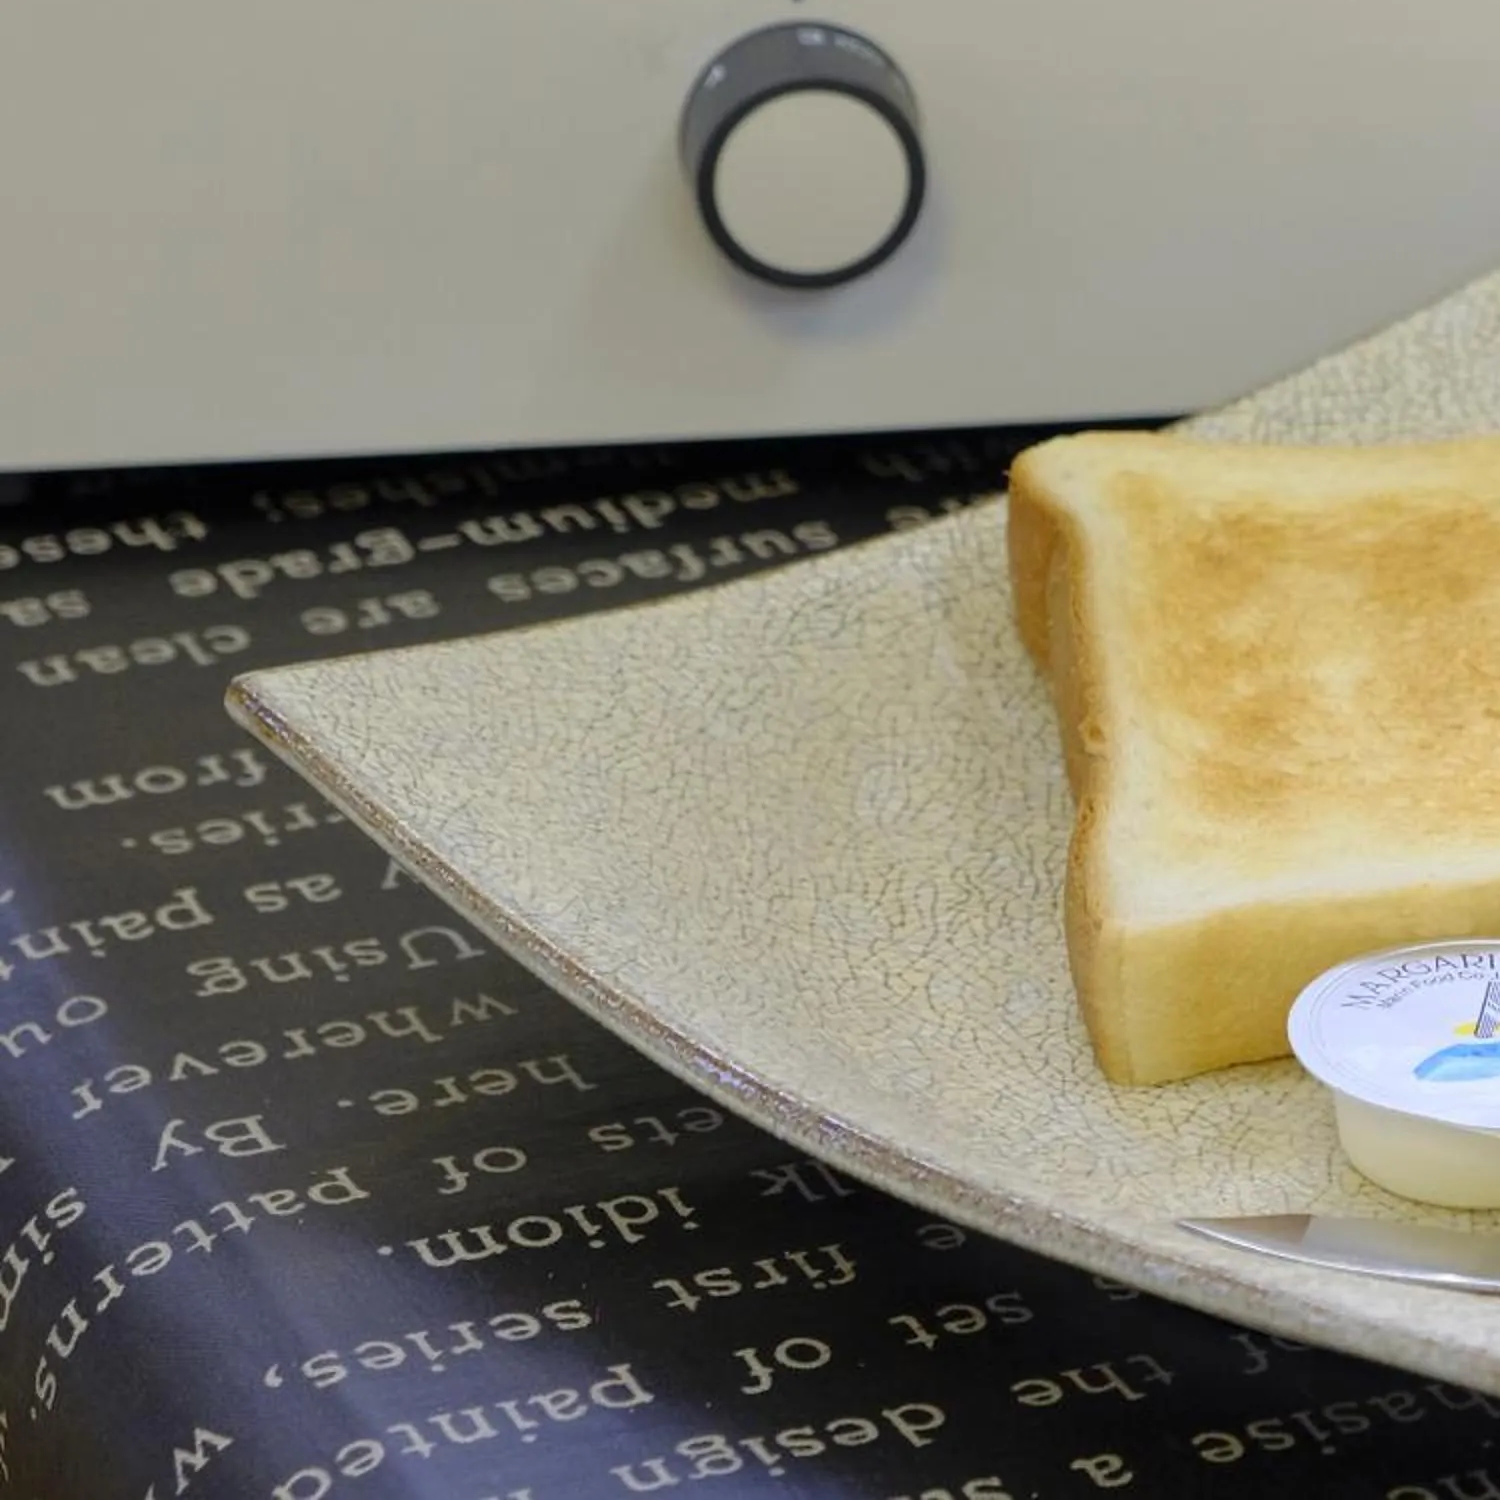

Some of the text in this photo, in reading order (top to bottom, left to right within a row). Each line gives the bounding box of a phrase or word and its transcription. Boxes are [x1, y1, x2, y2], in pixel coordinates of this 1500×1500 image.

[167, 467, 797, 601] medium-grade
[15, 519, 840, 688] surfaces are clean
[44, 746, 267, 812] from
[243, 872, 343, 915] as
[185, 923, 485, 998] Using
[68, 990, 518, 1121] wherever
[336, 1052, 595, 1122] here.
[150, 1113, 288, 1173] By
[432, 1146, 528, 1194] of
[375, 1185, 699, 1270] idiom.
[29, 1166, 369, 1422] patterns.
[261, 1242, 857, 1390] first series,
[887, 1291, 1035, 1350] set
[731, 1336, 833, 1396] of
[1009, 1353, 1175, 1408] the
[609, 1402, 946, 1496] design
[1069, 1453, 1134, 1488] a
